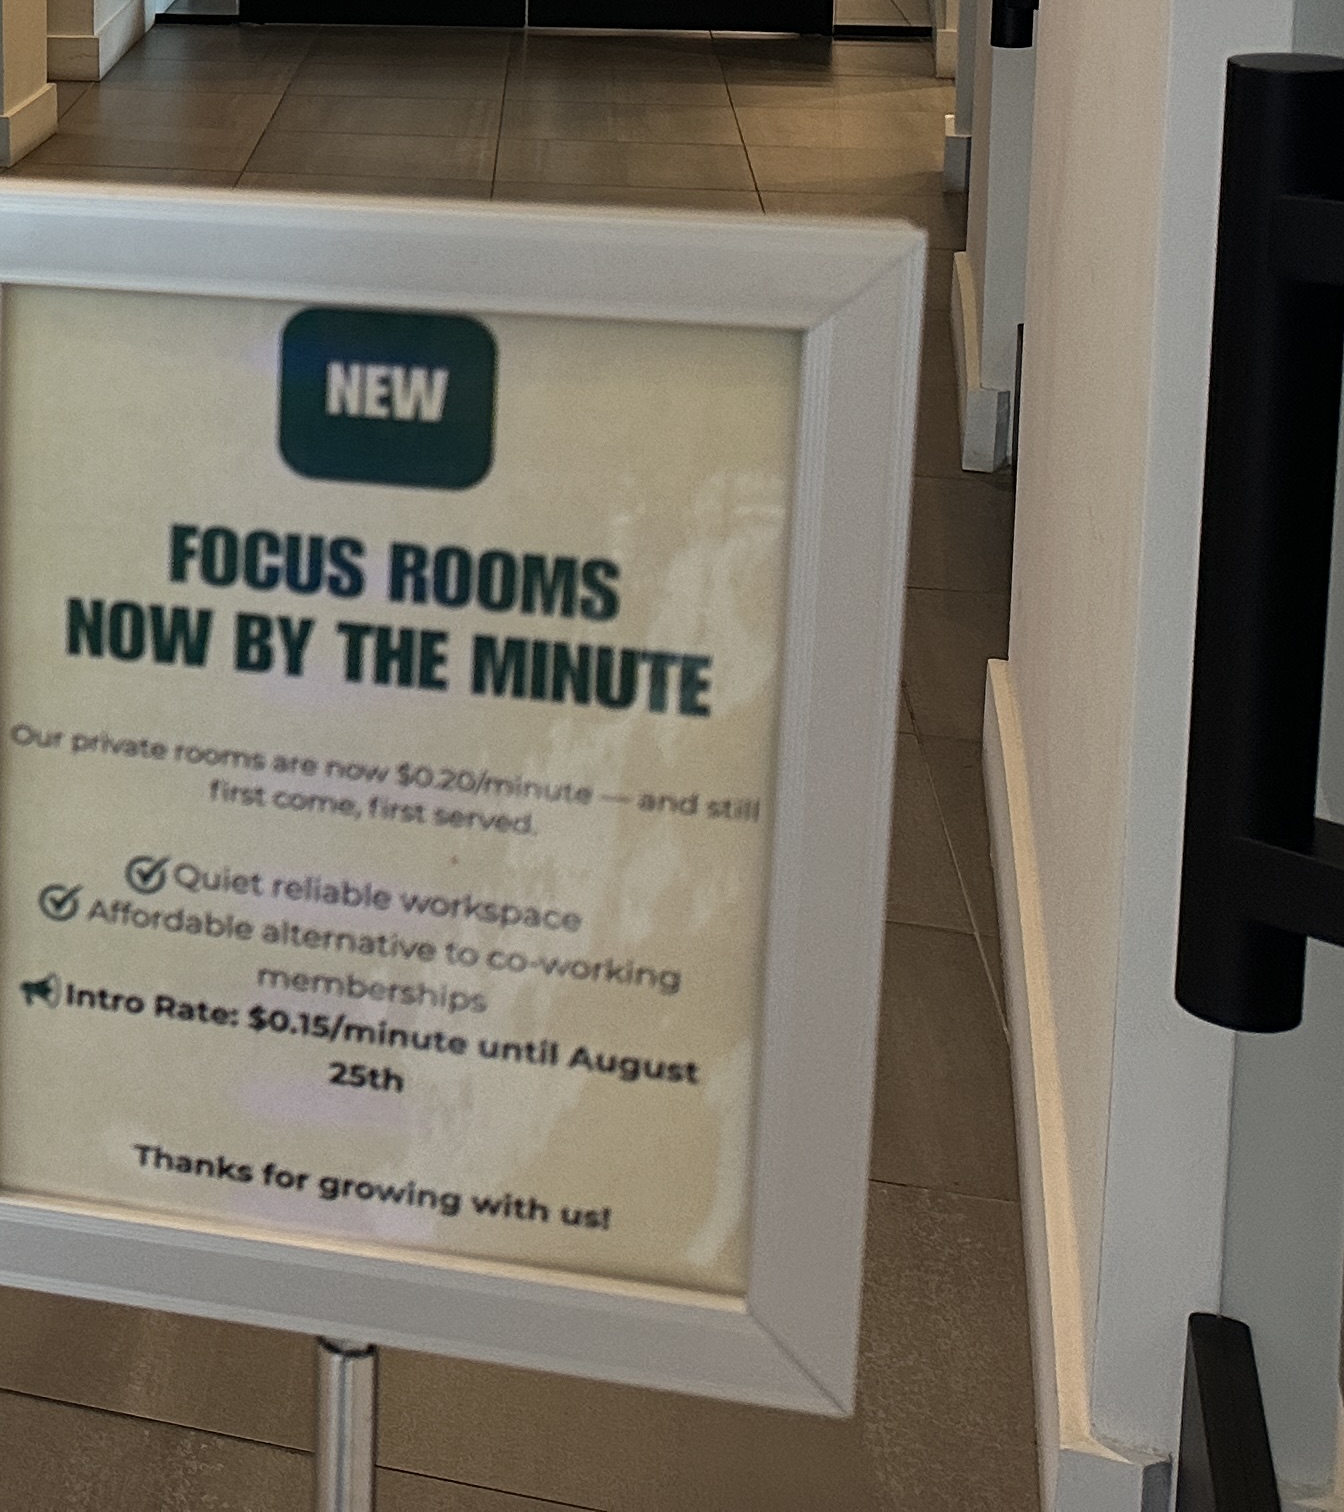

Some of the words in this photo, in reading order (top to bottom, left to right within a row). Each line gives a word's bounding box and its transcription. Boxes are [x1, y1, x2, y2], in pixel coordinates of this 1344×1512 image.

[325, 361, 448, 423] NEW
[169, 523, 365, 598] FOCUS
[388, 543, 620, 621] ROOMS
[66, 597, 214, 668] NOW
[234, 611, 313, 677] BY
[336, 621, 448, 692] THE
[471, 635, 714, 719] MINUTE
[10, 724, 63, 753] Our
[71, 732, 168, 765] private
[174, 745, 267, 772] rooms
[272, 753, 320, 776] are
[325, 758, 392, 787] now
[396, 761, 593, 808] $0.20/minute
[637, 792, 698, 819] and
[706, 794, 761, 823] still
[208, 778, 265, 809] first
[270, 787, 361, 821] come,
[367, 793, 425, 824] first
[433, 806, 537, 838] served.
[174, 862, 264, 898] Quiet
[271, 873, 392, 912] reliable
[400, 892, 582, 935] workspace
[88, 898, 255, 941] Affordable
[262, 918, 436, 964] alternative
[443, 940, 481, 966] to
[488, 945, 681, 995] co-working
[255, 964, 487, 1016] memberships
[66, 983, 145, 1016] Intro
[154, 994, 239, 1028] Rate:
[247, 1004, 468, 1059] $0.15/minute
[478, 1034, 560, 1067] until
[568, 1043, 700, 1086] August
[328, 1063, 404, 1094] 25th
[133, 1142, 255, 1185] Thanks
[261, 1160, 308, 1192] for
[318, 1171, 460, 1218] growing
[471, 1190, 549, 1225] with
[559, 1202, 612, 1233] us!
